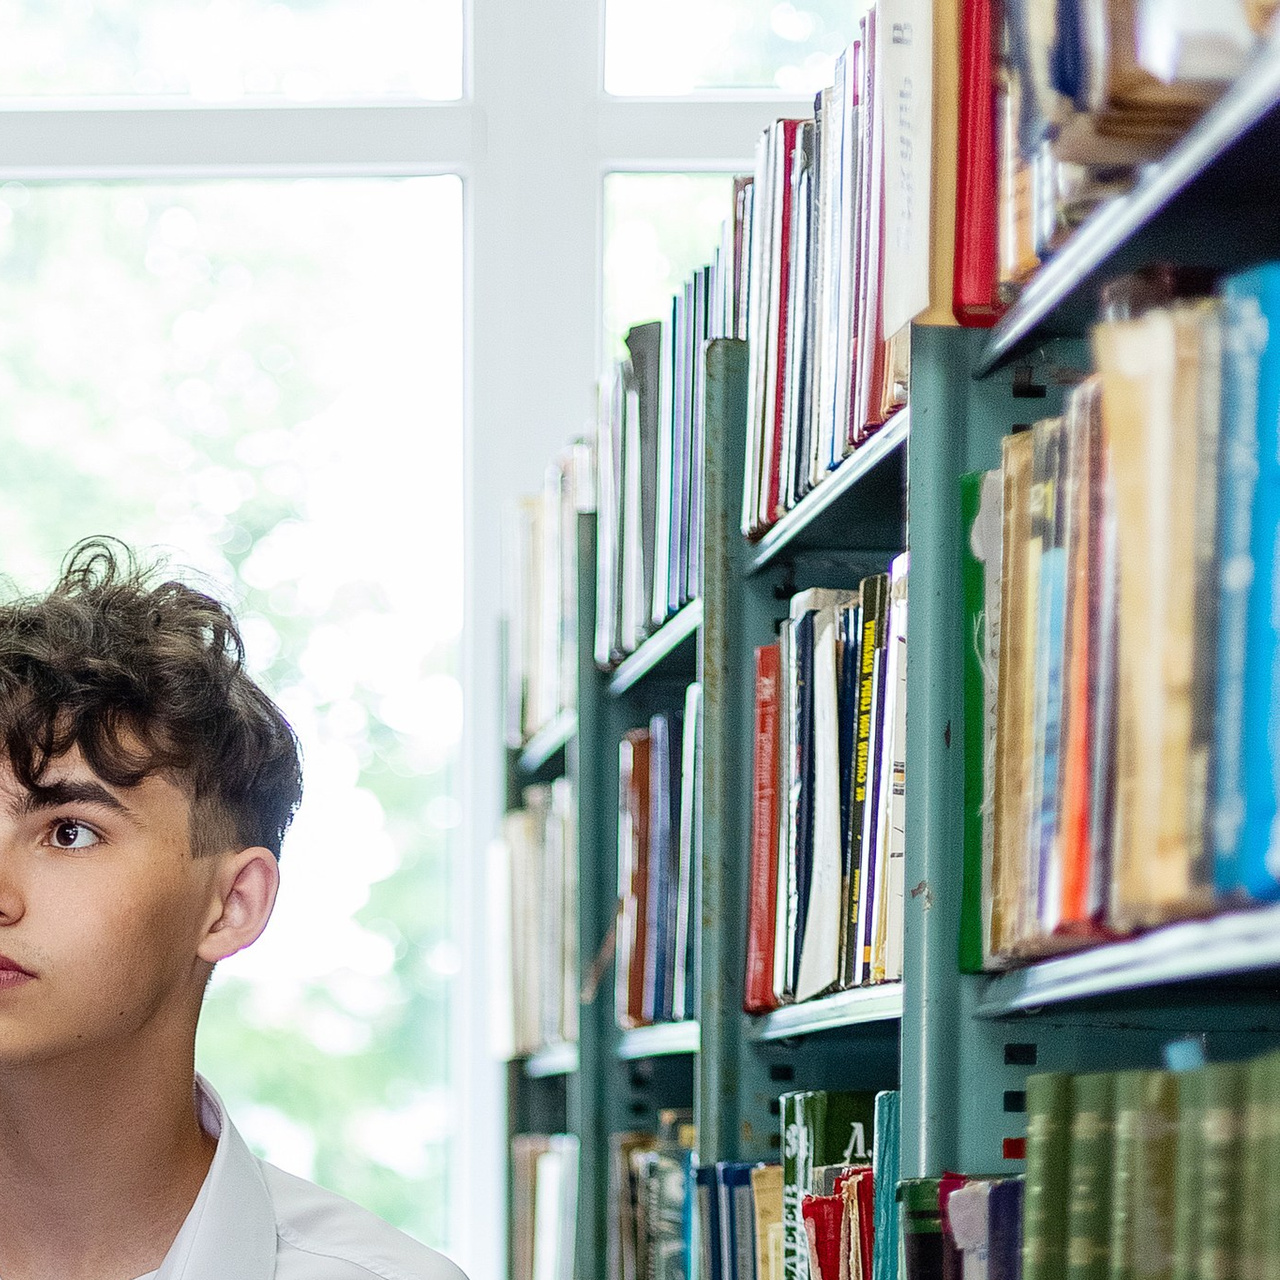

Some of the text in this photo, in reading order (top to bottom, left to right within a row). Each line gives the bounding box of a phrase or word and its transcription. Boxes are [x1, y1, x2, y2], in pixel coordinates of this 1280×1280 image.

[862, 620, 876, 673] КУКУШКА
[858, 714, 871, 738] МОИ
[856, 740, 869, 784] СЧИТАЙ
[855, 786, 865, 802] НЕ
